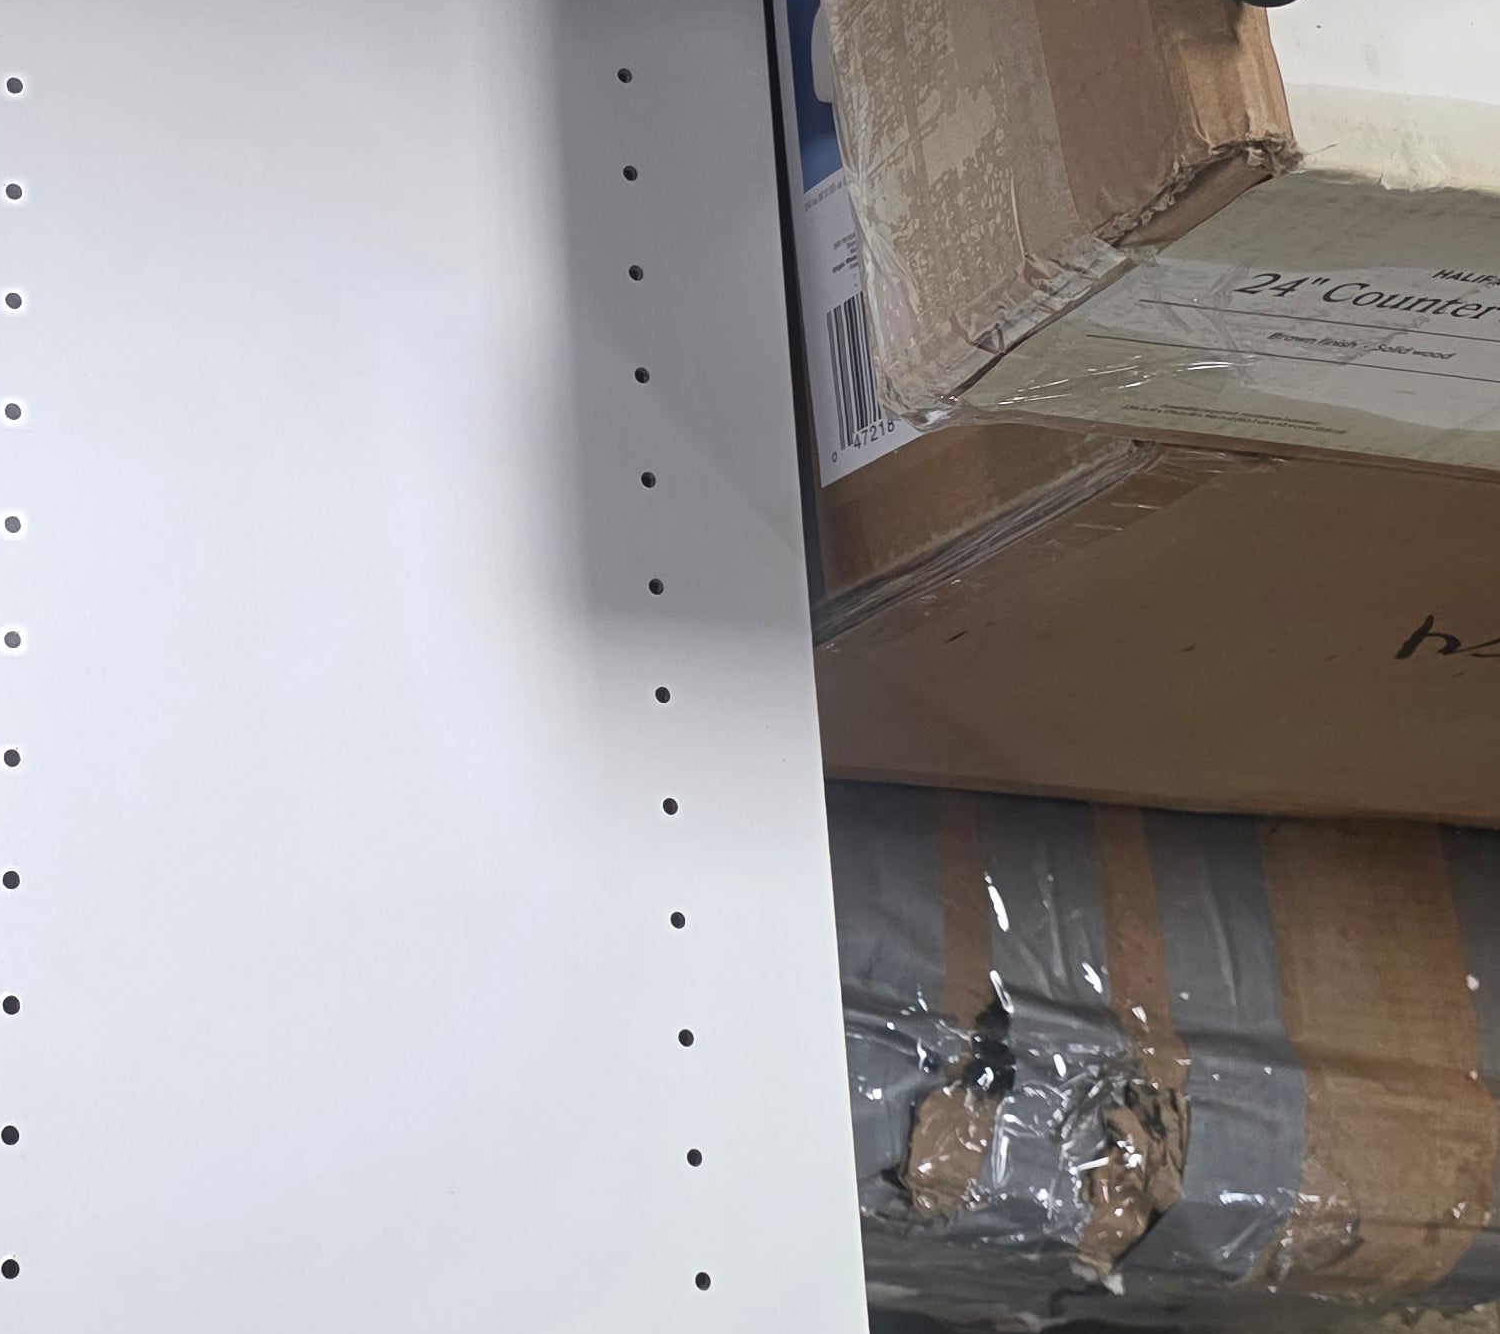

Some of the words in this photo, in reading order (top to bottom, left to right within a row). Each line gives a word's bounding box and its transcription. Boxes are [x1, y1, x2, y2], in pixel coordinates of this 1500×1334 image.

[1322, 282, 1500, 320] Counter
[1267, 332, 1317, 345] Brown
[1320, 337, 1358, 349] finish
[1412, 350, 1458, 361] wood
[831, 451, 838, 464] 0
